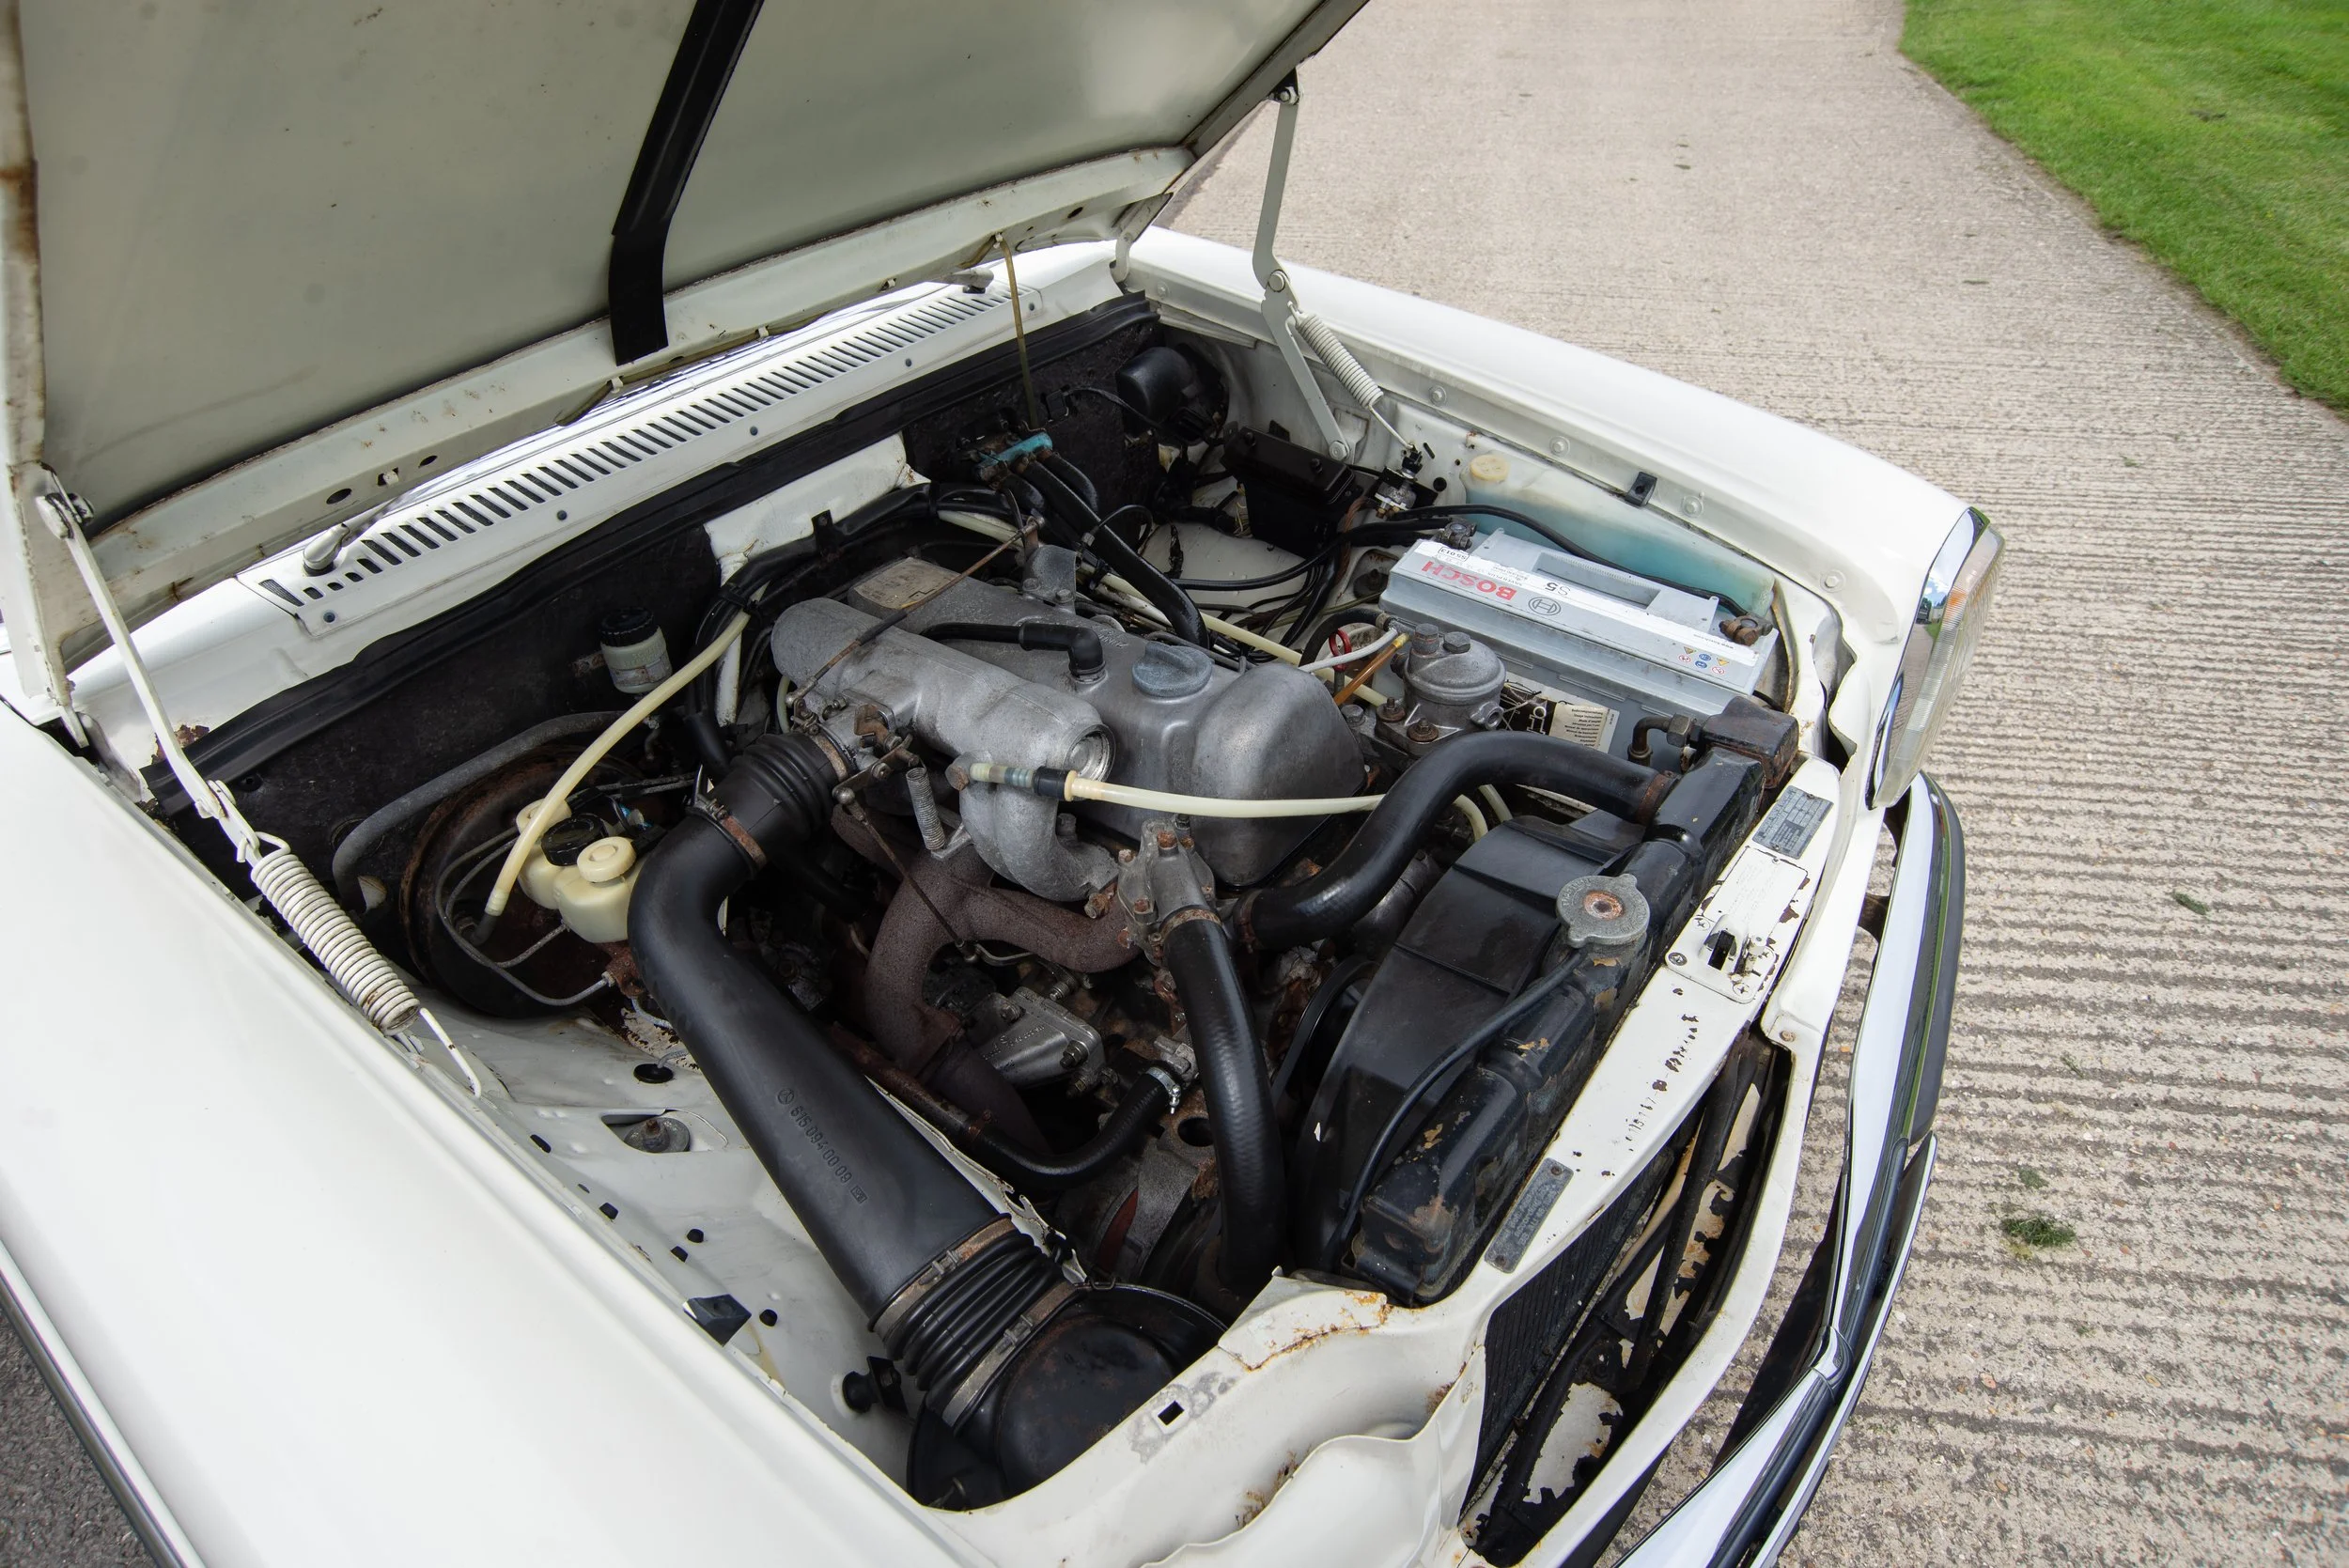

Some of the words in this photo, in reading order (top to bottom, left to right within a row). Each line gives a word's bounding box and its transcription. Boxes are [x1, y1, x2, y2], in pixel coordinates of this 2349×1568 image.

[1421, 561, 1517, 601] BOSCH
[1545, 582, 1571, 597] S5
[822, 1149, 840, 1167] 00
[835, 1165, 853, 1184] 09
